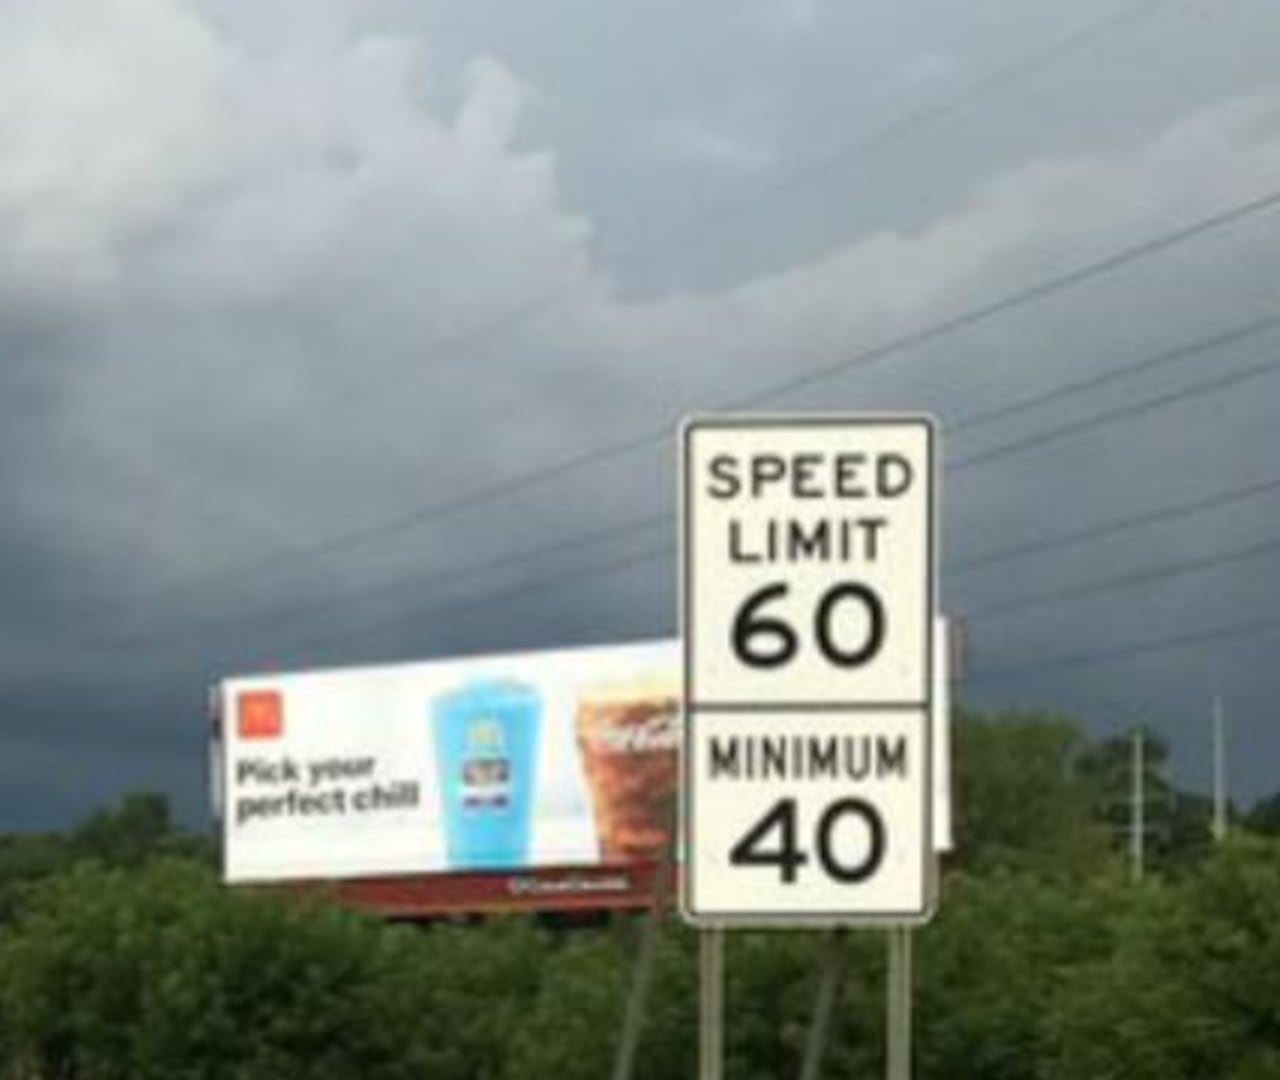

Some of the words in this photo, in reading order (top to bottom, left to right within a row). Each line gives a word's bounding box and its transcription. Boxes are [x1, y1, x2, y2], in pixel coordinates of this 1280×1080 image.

[707, 452, 914, 500] SPEED
[728, 517, 887, 564] LIMIT
[730, 580, 886, 671] 60
[236, 758, 300, 787] Pick
[310, 756, 375, 788] your
[708, 734, 907, 782] MINIMUM
[237, 787, 346, 826] perfect
[351, 779, 421, 813] chill
[728, 796, 887, 886] 40
